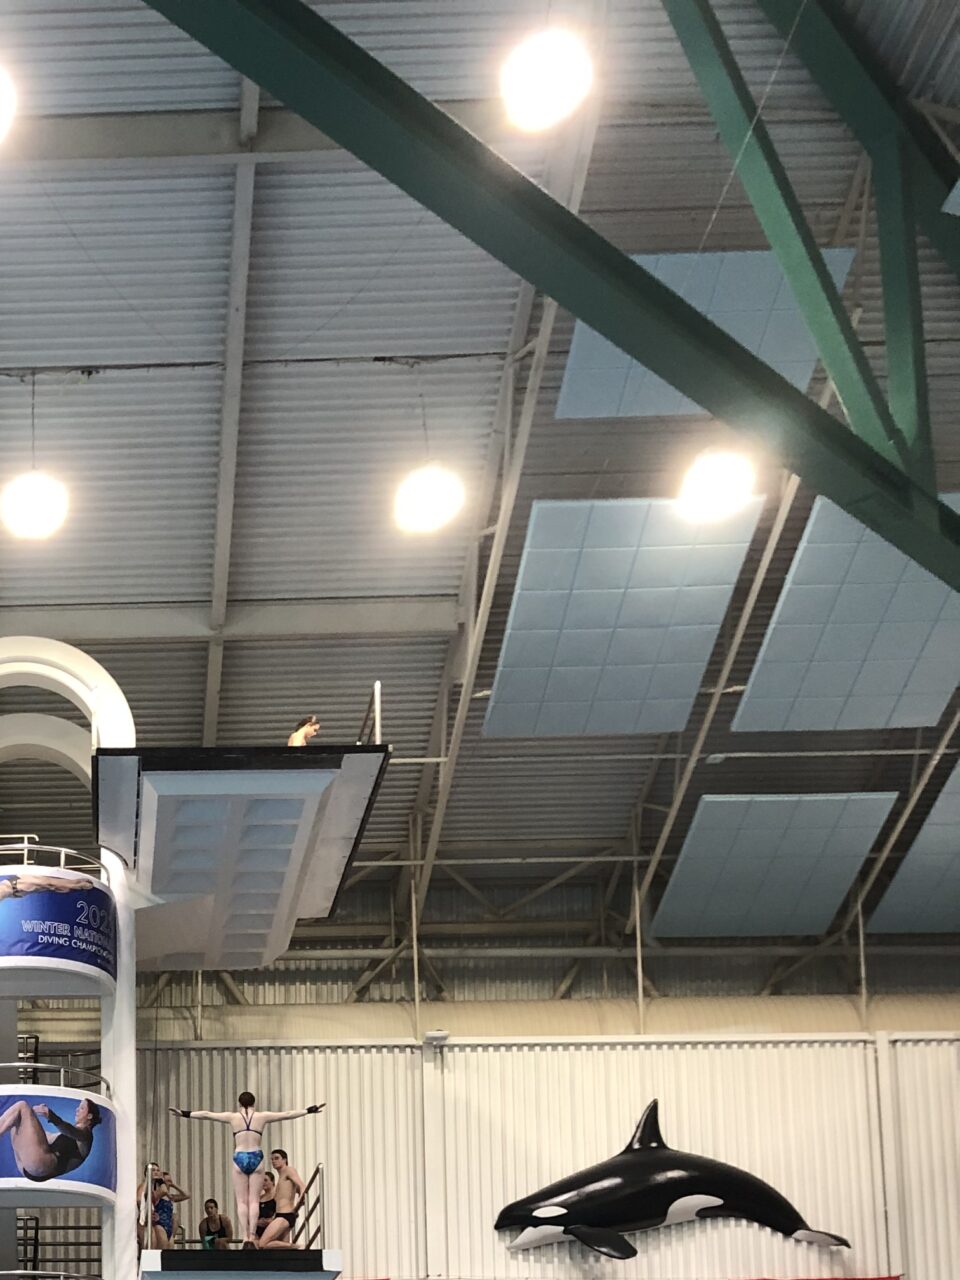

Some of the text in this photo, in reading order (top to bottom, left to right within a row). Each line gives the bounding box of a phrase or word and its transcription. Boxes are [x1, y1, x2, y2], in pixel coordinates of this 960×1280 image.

[76, 900, 114, 935] 202
[21, 919, 71, 936] WINTER
[38, 935, 70, 946] DIVING
